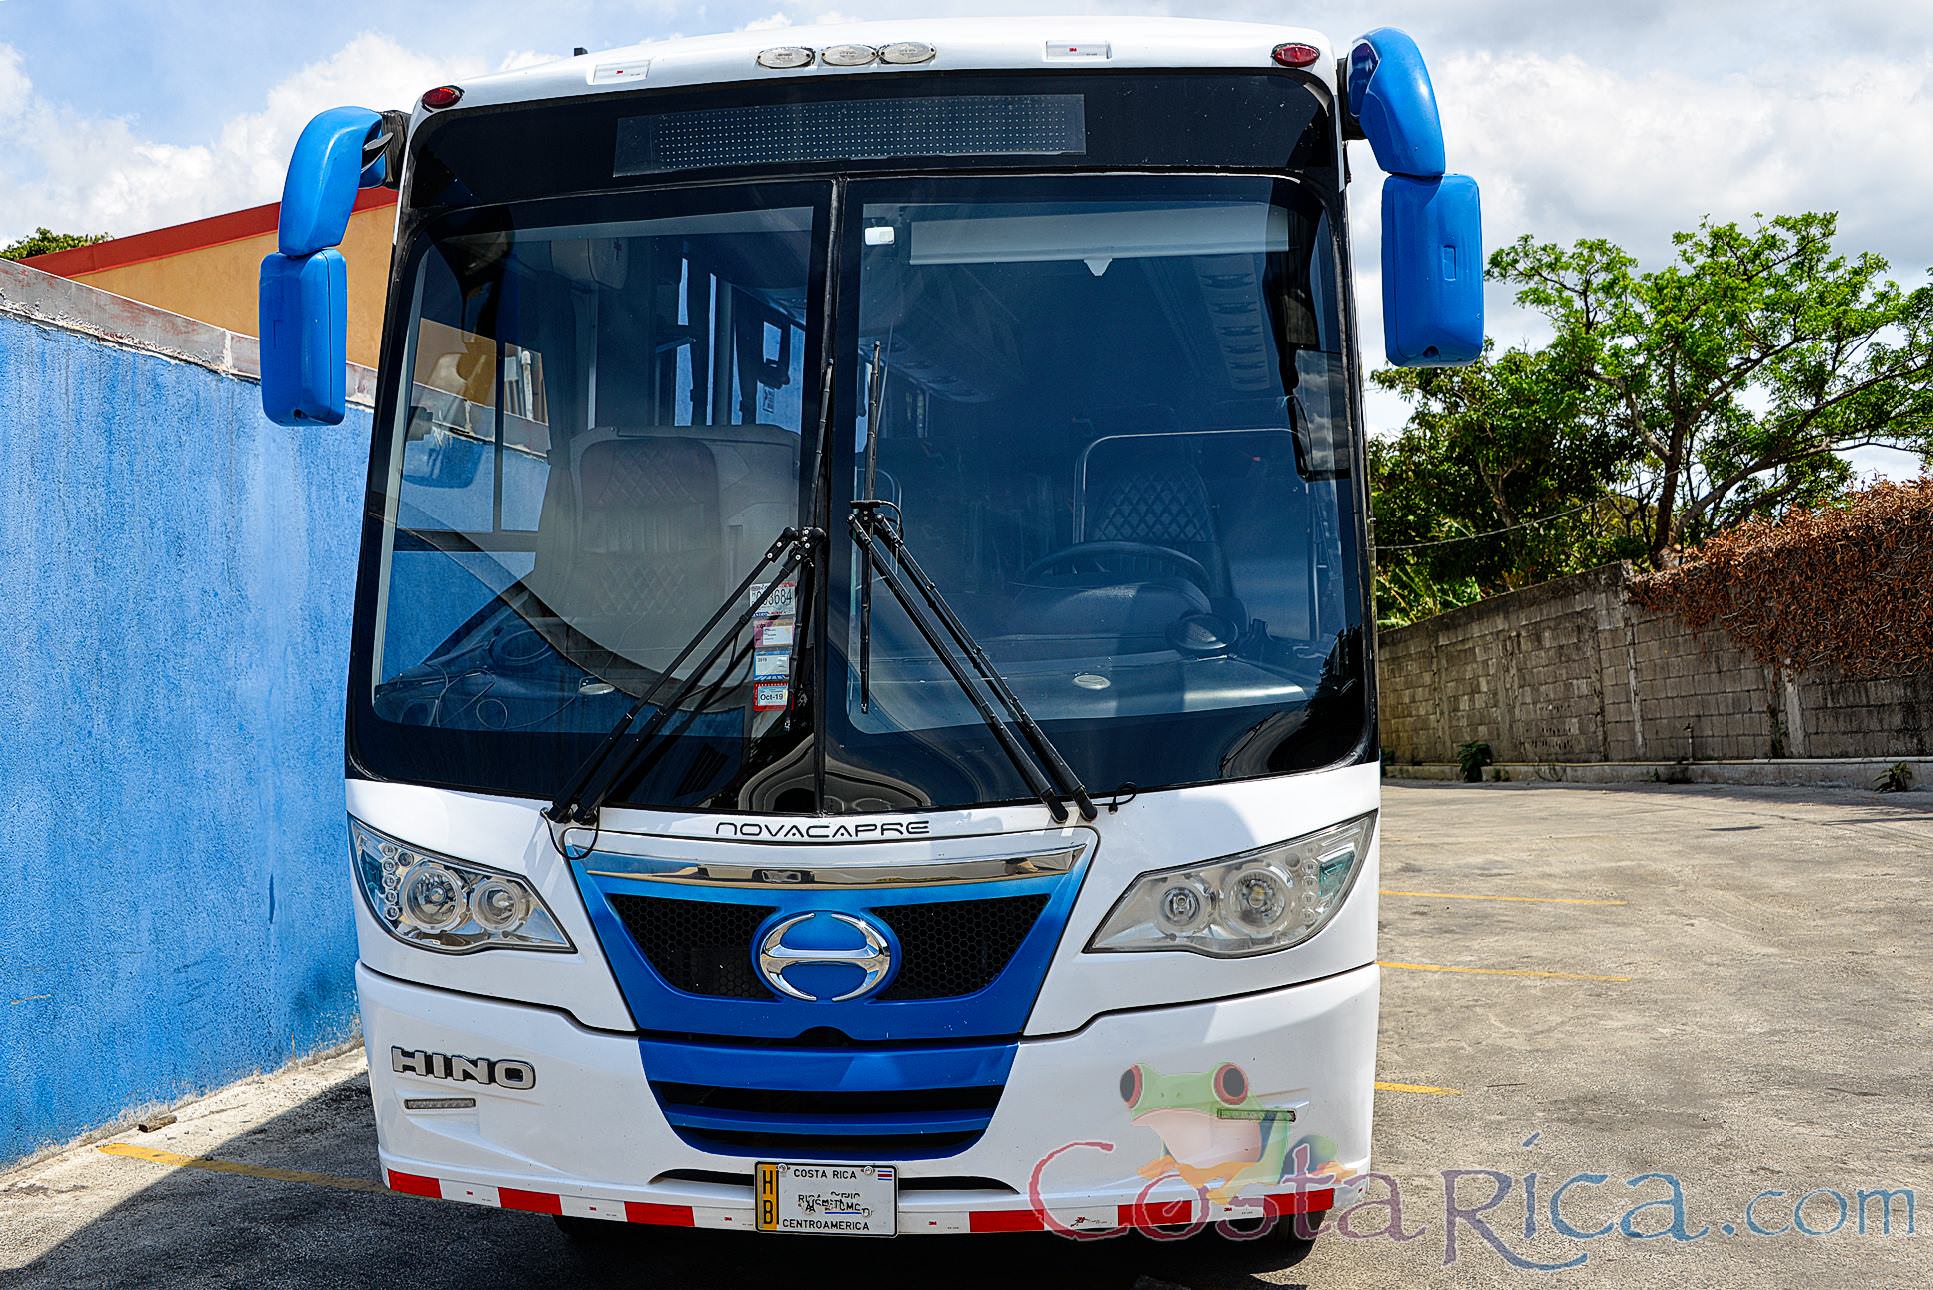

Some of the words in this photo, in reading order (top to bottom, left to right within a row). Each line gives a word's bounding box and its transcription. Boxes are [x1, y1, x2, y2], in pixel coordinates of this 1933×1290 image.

[760, 693, 784, 701] Oct-19
[716, 820, 930, 838] NOVACAPRE
[391, 1045, 536, 1090] HINO
[793, 1168, 828, 1179] COSTA
[832, 1169, 857, 1180] RICA
[782, 1218, 870, 1231] CENTROAMERICA
